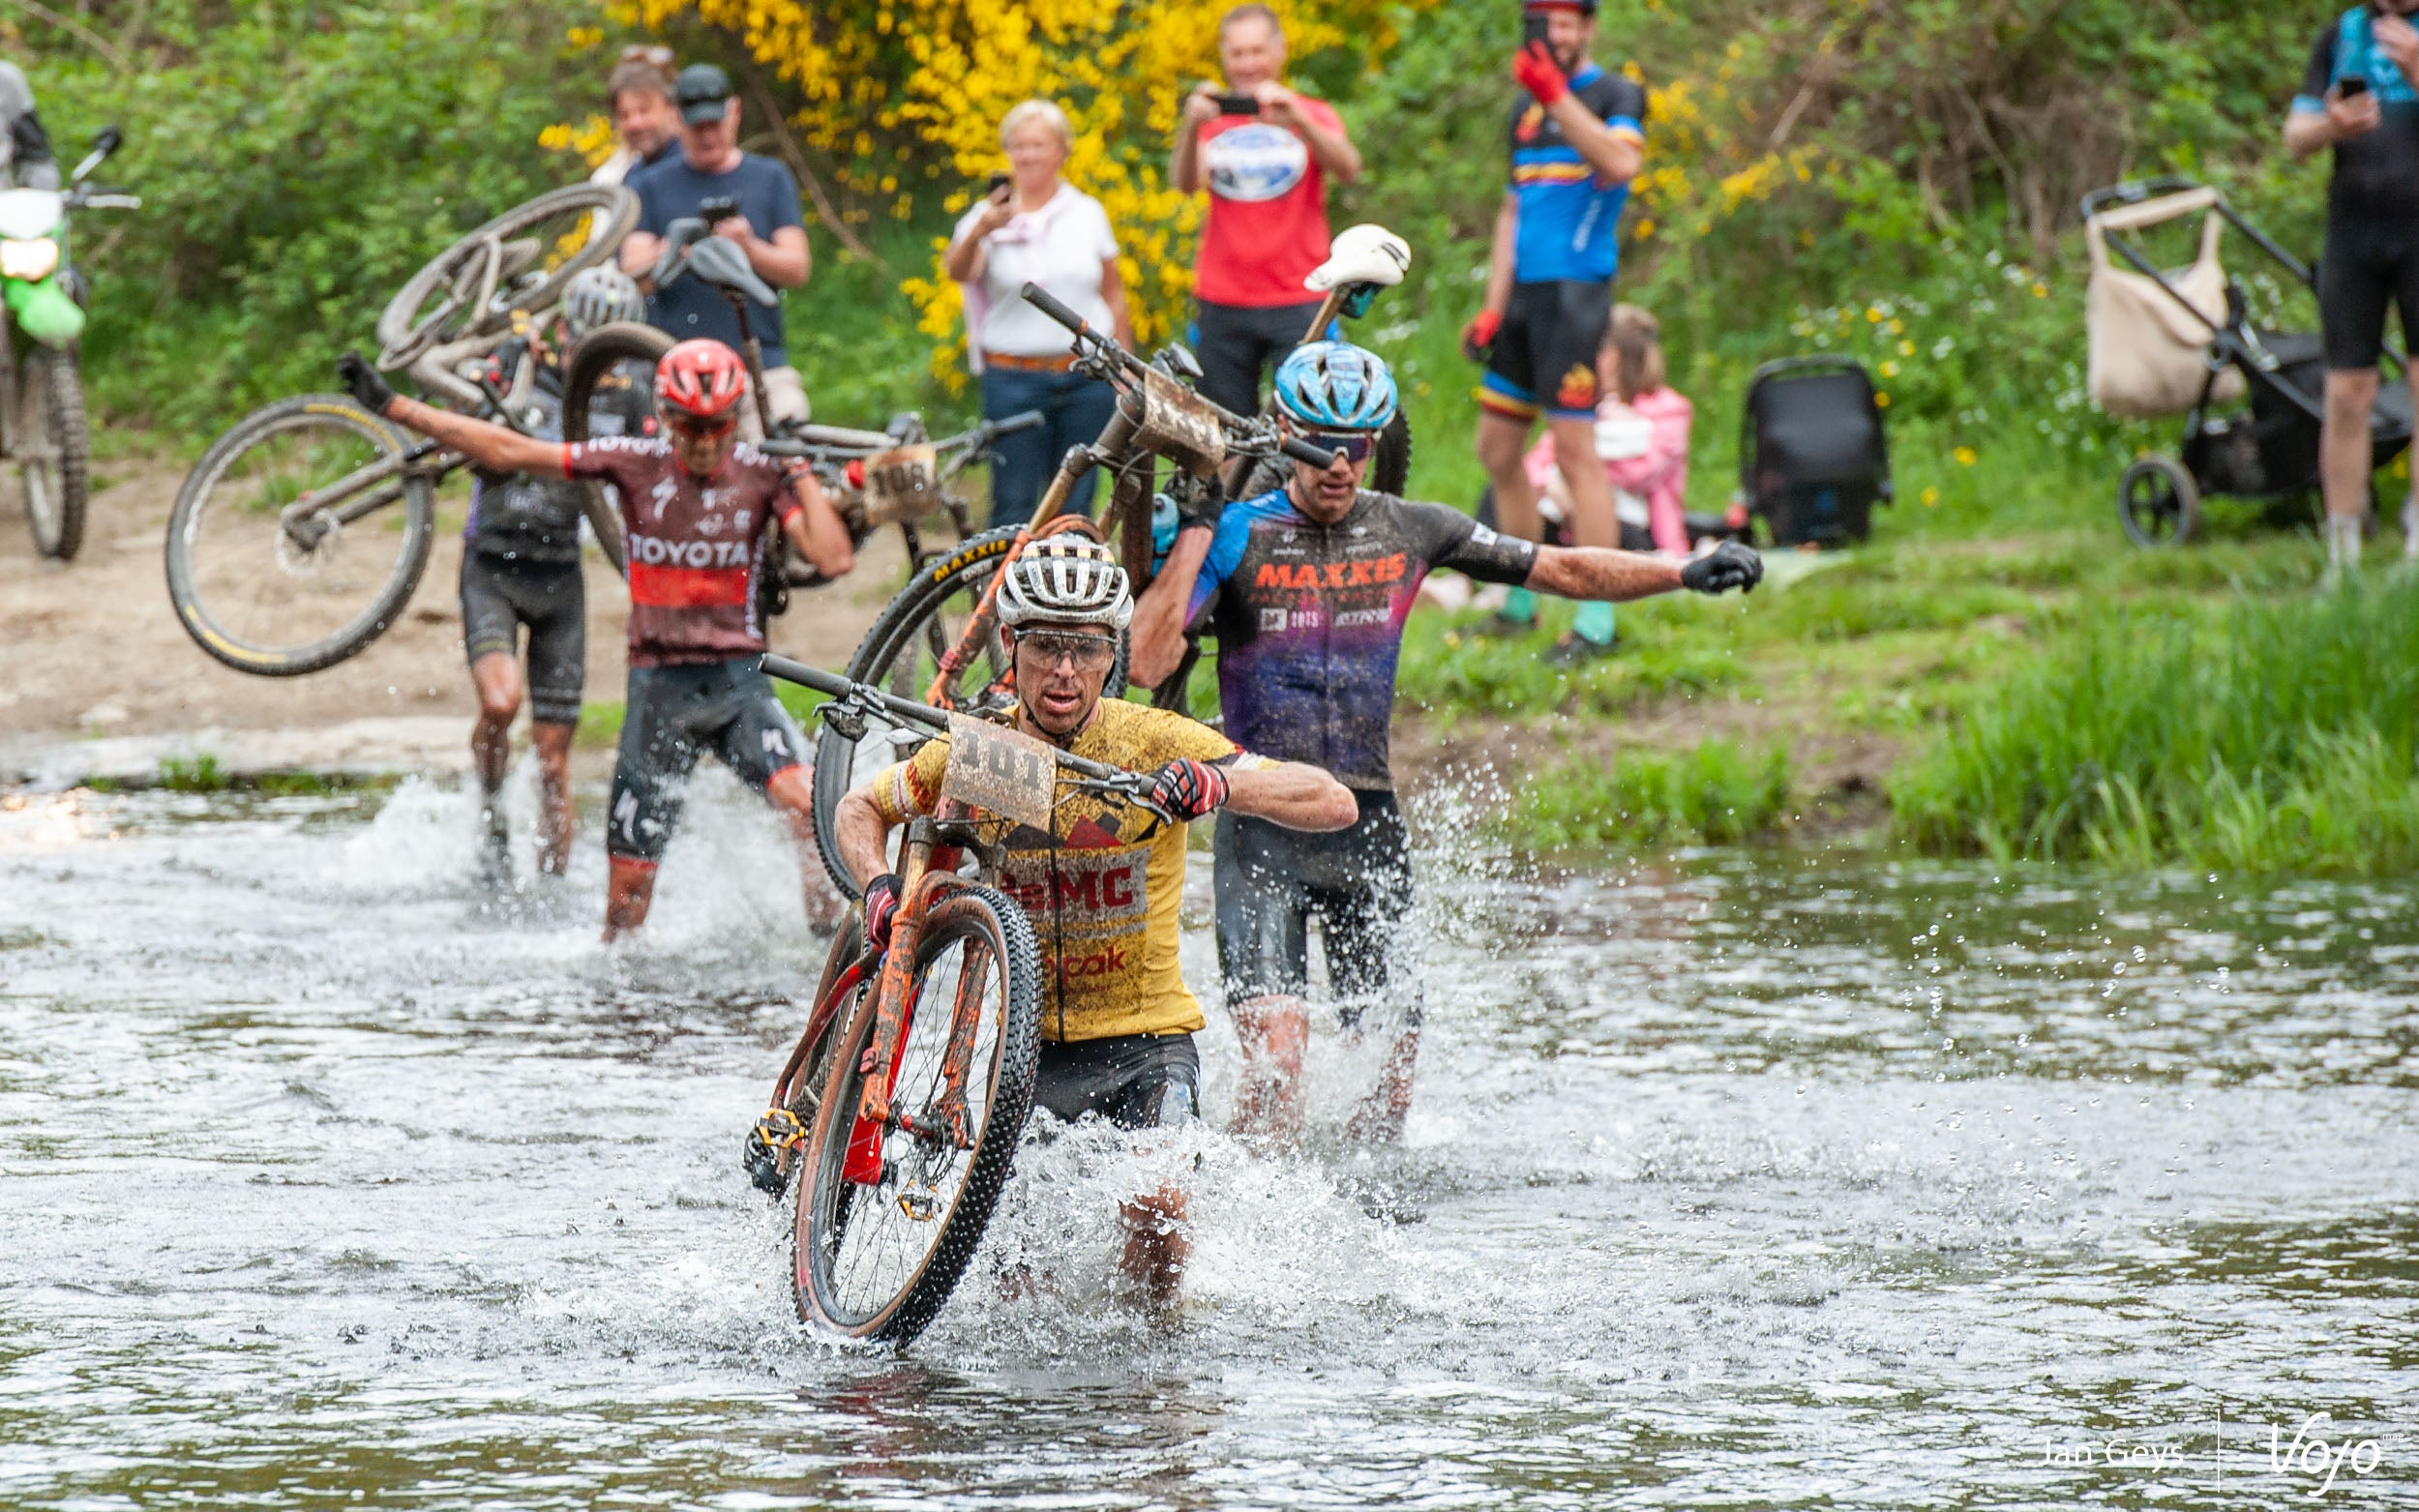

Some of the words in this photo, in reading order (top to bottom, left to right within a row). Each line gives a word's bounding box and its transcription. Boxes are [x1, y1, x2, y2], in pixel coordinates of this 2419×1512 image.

[629, 534, 750, 568] TOYOTA
[934, 540, 1006, 582] MAXXIS
[1255, 552, 1407, 588] MAXXIS
[961, 731, 1041, 790] 101
